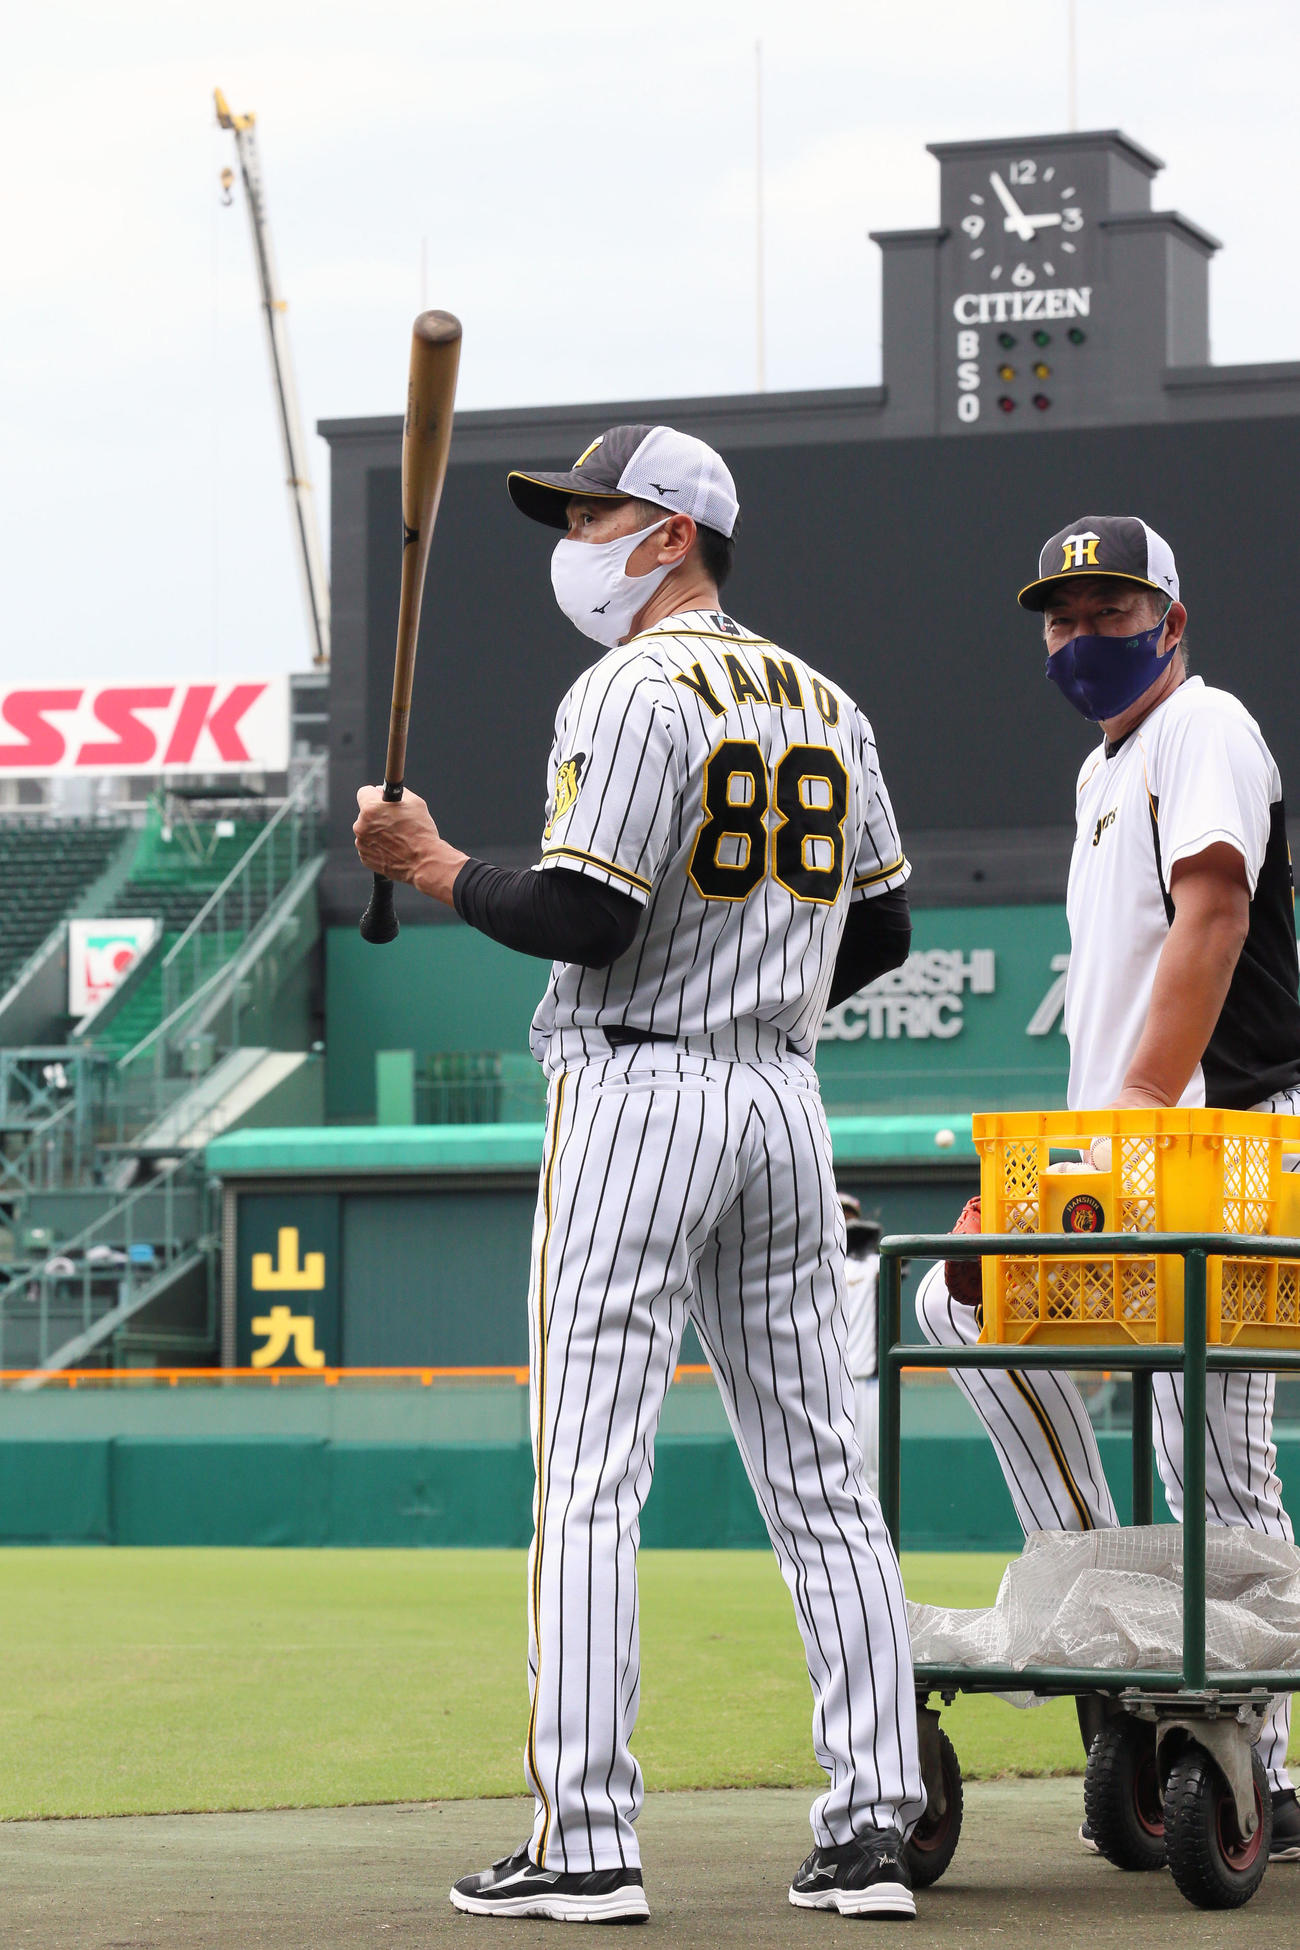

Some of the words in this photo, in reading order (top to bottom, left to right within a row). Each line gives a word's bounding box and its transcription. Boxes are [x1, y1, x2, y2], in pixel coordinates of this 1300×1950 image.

[1010, 160, 1037, 184] 12
[961, 215, 986, 239] 9
[1061, 207, 1085, 232] 3
[1011, 263, 1036, 287] 6
[953, 286, 1092, 325] CITIZEN
[674, 653, 839, 728] YANO
[0, 682, 268, 766] SSK
[686, 738, 850, 907] 88
[860, 949, 995, 994] BISHI
[252, 1226, 325, 1368] 山九
